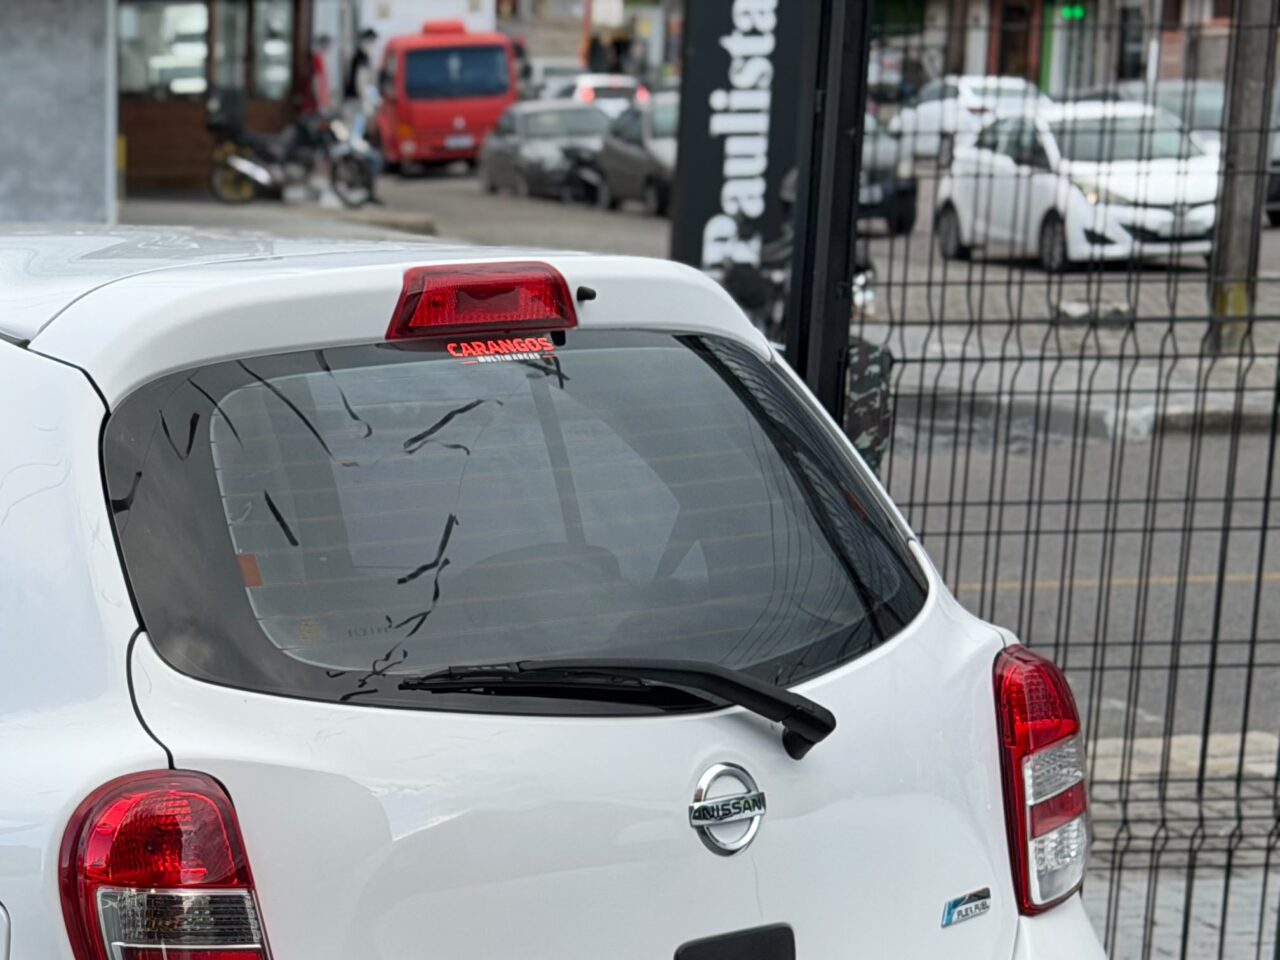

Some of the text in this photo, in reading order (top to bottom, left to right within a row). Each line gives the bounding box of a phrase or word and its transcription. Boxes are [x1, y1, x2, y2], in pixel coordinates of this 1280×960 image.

[702, 0, 778, 266] Paulista
[447, 337, 554, 357] CARANGOS
[477, 352, 540, 362] MULTIMARCAS
[701, 797, 762, 820] NISSAN
